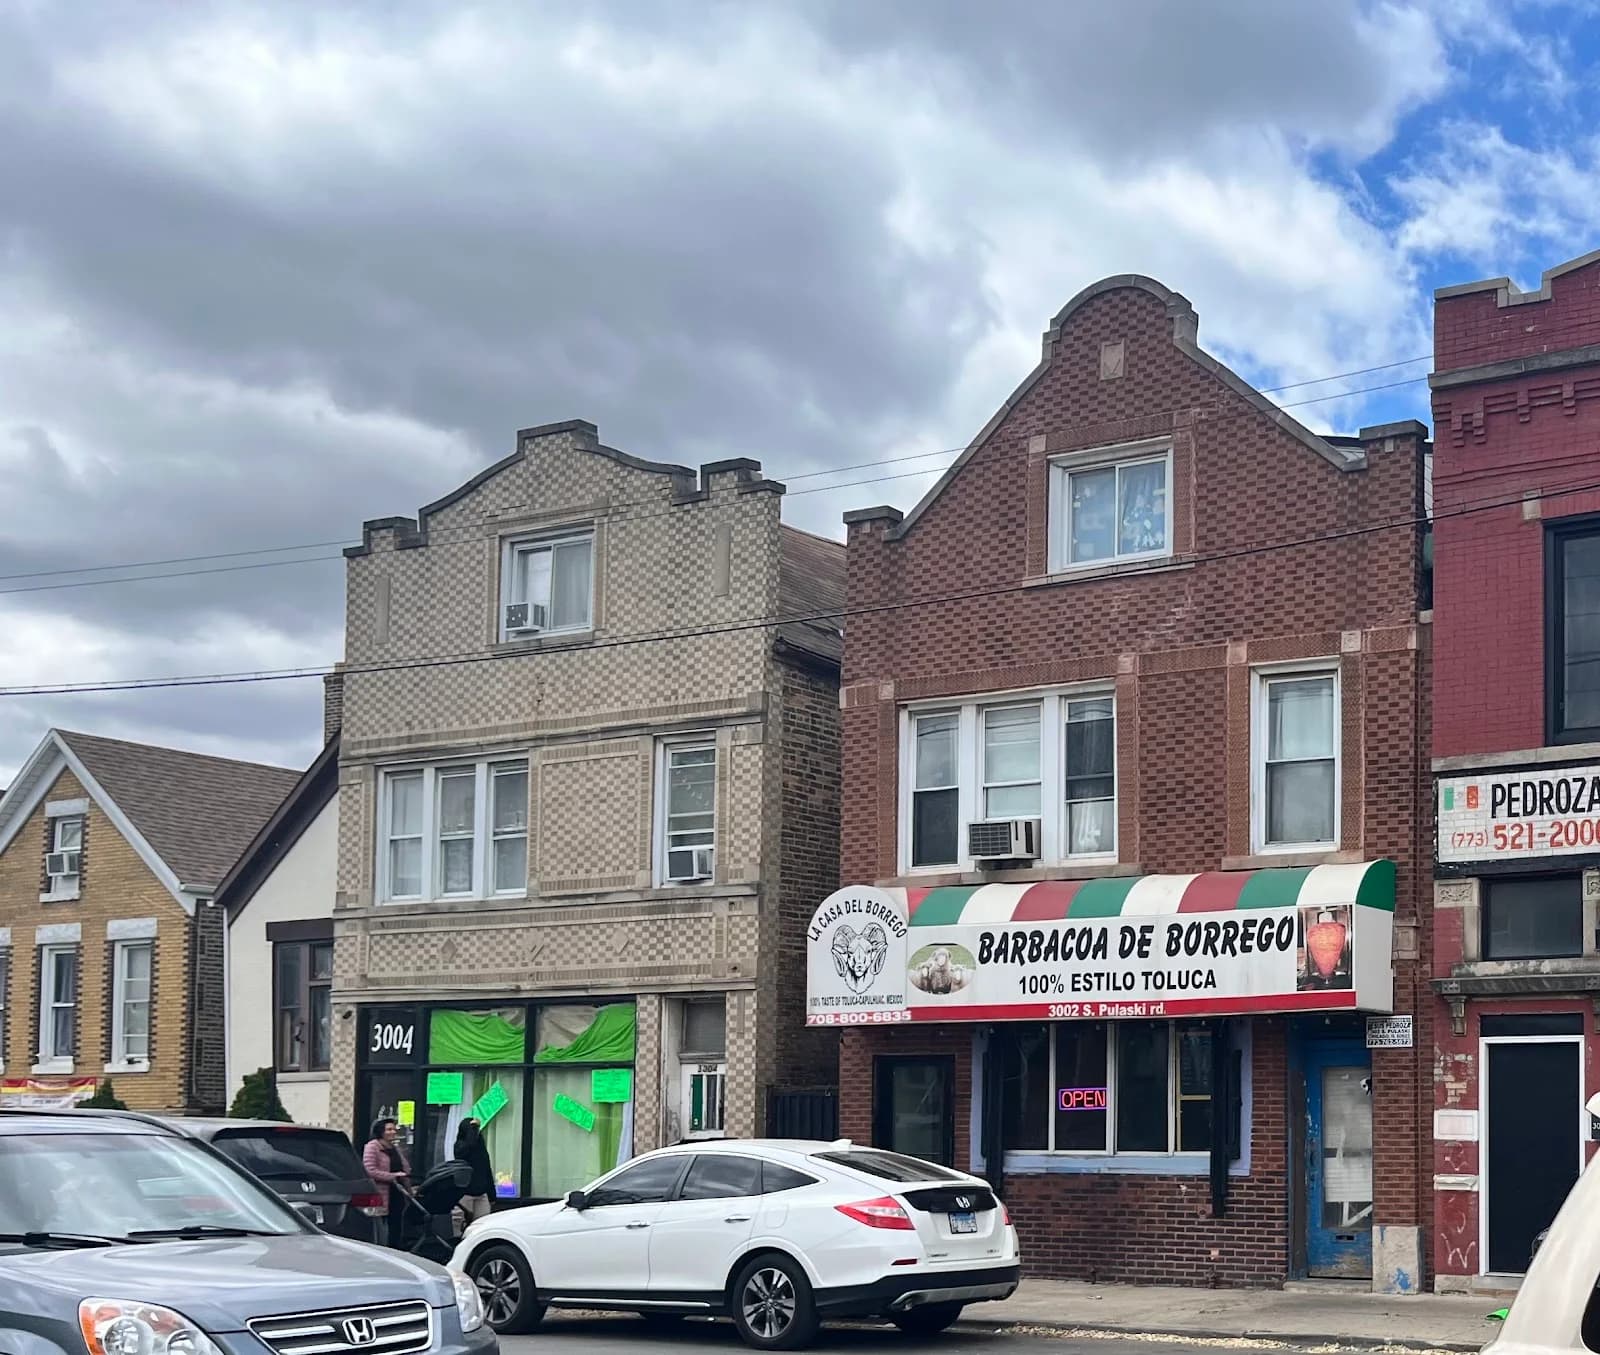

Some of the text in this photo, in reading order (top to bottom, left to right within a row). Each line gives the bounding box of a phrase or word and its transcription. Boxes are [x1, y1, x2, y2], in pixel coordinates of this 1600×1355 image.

[1491, 775, 1600, 818] PEDROZA
[1452, 830, 1489, 848] (773)
[807, 899, 907, 942] LA CASA DEL BORREGO
[978, 915, 1295, 966] BARBACOA DE BORREGO
[1019, 969, 1217, 995] 100% ESTILO TOLUCA
[821, 996, 835, 1007] TASTE
[886, 994, 904, 1005] MEXICO
[1048, 1002, 1167, 1017] 3002 S. Pulaski rd.
[807, 1010, 912, 1024] 708-800-6835
[371, 1023, 414, 1055] 3004
[1061, 1090, 1106, 1108] OPEN
